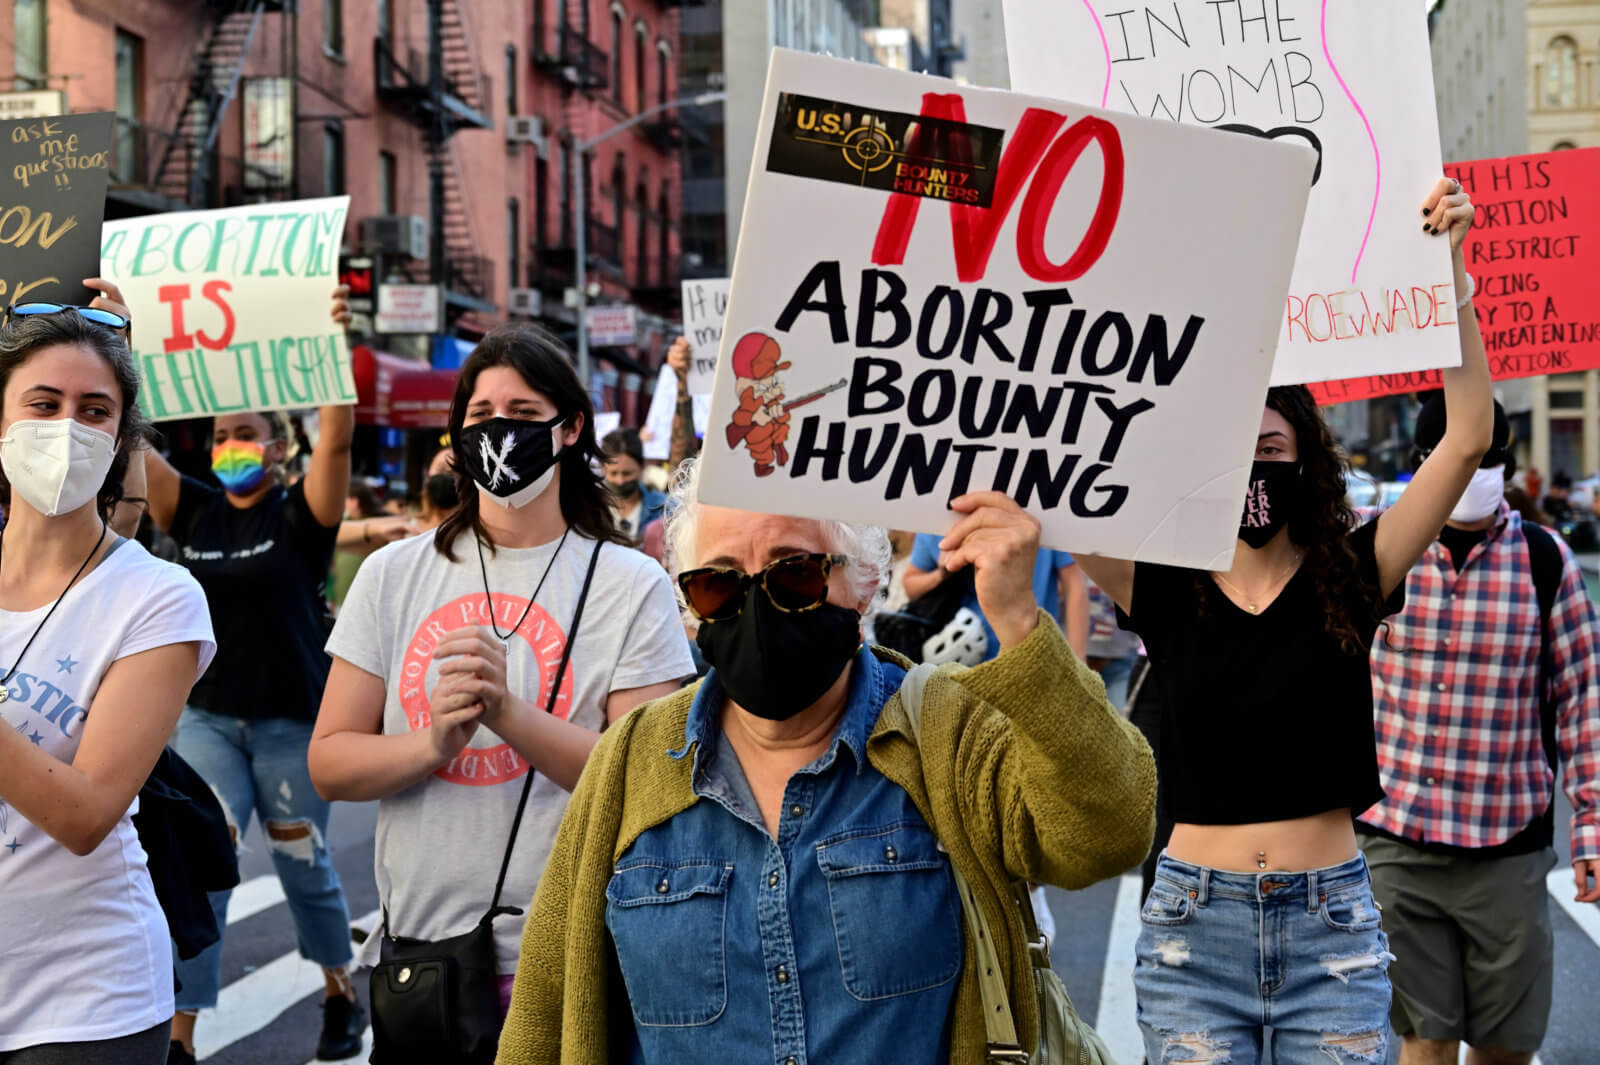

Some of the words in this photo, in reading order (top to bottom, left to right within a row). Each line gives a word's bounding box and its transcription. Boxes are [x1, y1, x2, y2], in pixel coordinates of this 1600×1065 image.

[1105, 2, 1190, 62] IN
[1208, 0, 1301, 46] THE
[1120, 51, 1324, 123] WOMB
[11, 120, 63, 144] ask
[796, 108, 845, 136] U.S.
[40, 133, 79, 156] me
[13, 150, 109, 188] questions
[871, 92, 1124, 283] NO
[895, 162, 969, 186] BOUNTY
[893, 177, 979, 202] HUNTERS
[100, 208, 345, 278] ABORTION
[1472, 235, 1581, 265] RESTRICT
[158, 280, 236, 354] IS
[775, 261, 1205, 386] ABORTION
[1504, 301, 1534, 323] TO
[1543, 295, 1559, 320] A
[848, 356, 1155, 463] BOUNTY
[790, 415, 1129, 518] HUNTING
[1240, 510, 1271, 527] AR
